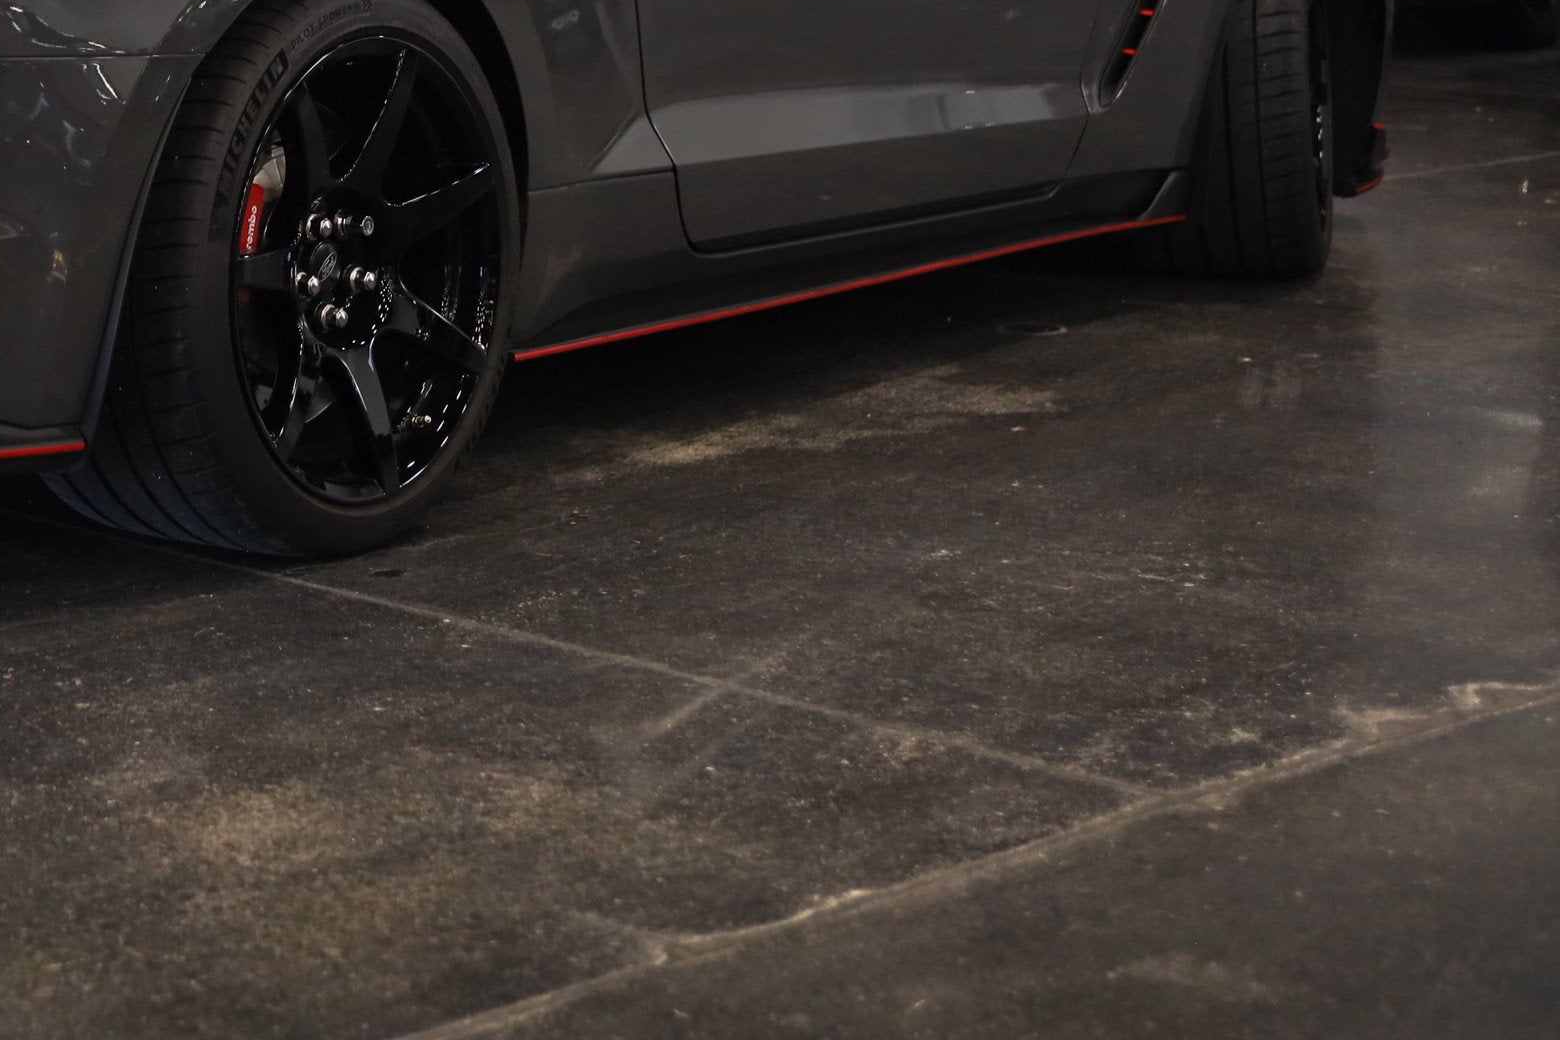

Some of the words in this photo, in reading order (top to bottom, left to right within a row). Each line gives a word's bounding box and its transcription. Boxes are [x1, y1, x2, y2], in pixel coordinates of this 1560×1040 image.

[291, 22, 316, 50] PILOT
[317, 5, 347, 28] SPORT
[218, 56, 285, 198] MICHELIN
[246, 205, 257, 251] rembo
